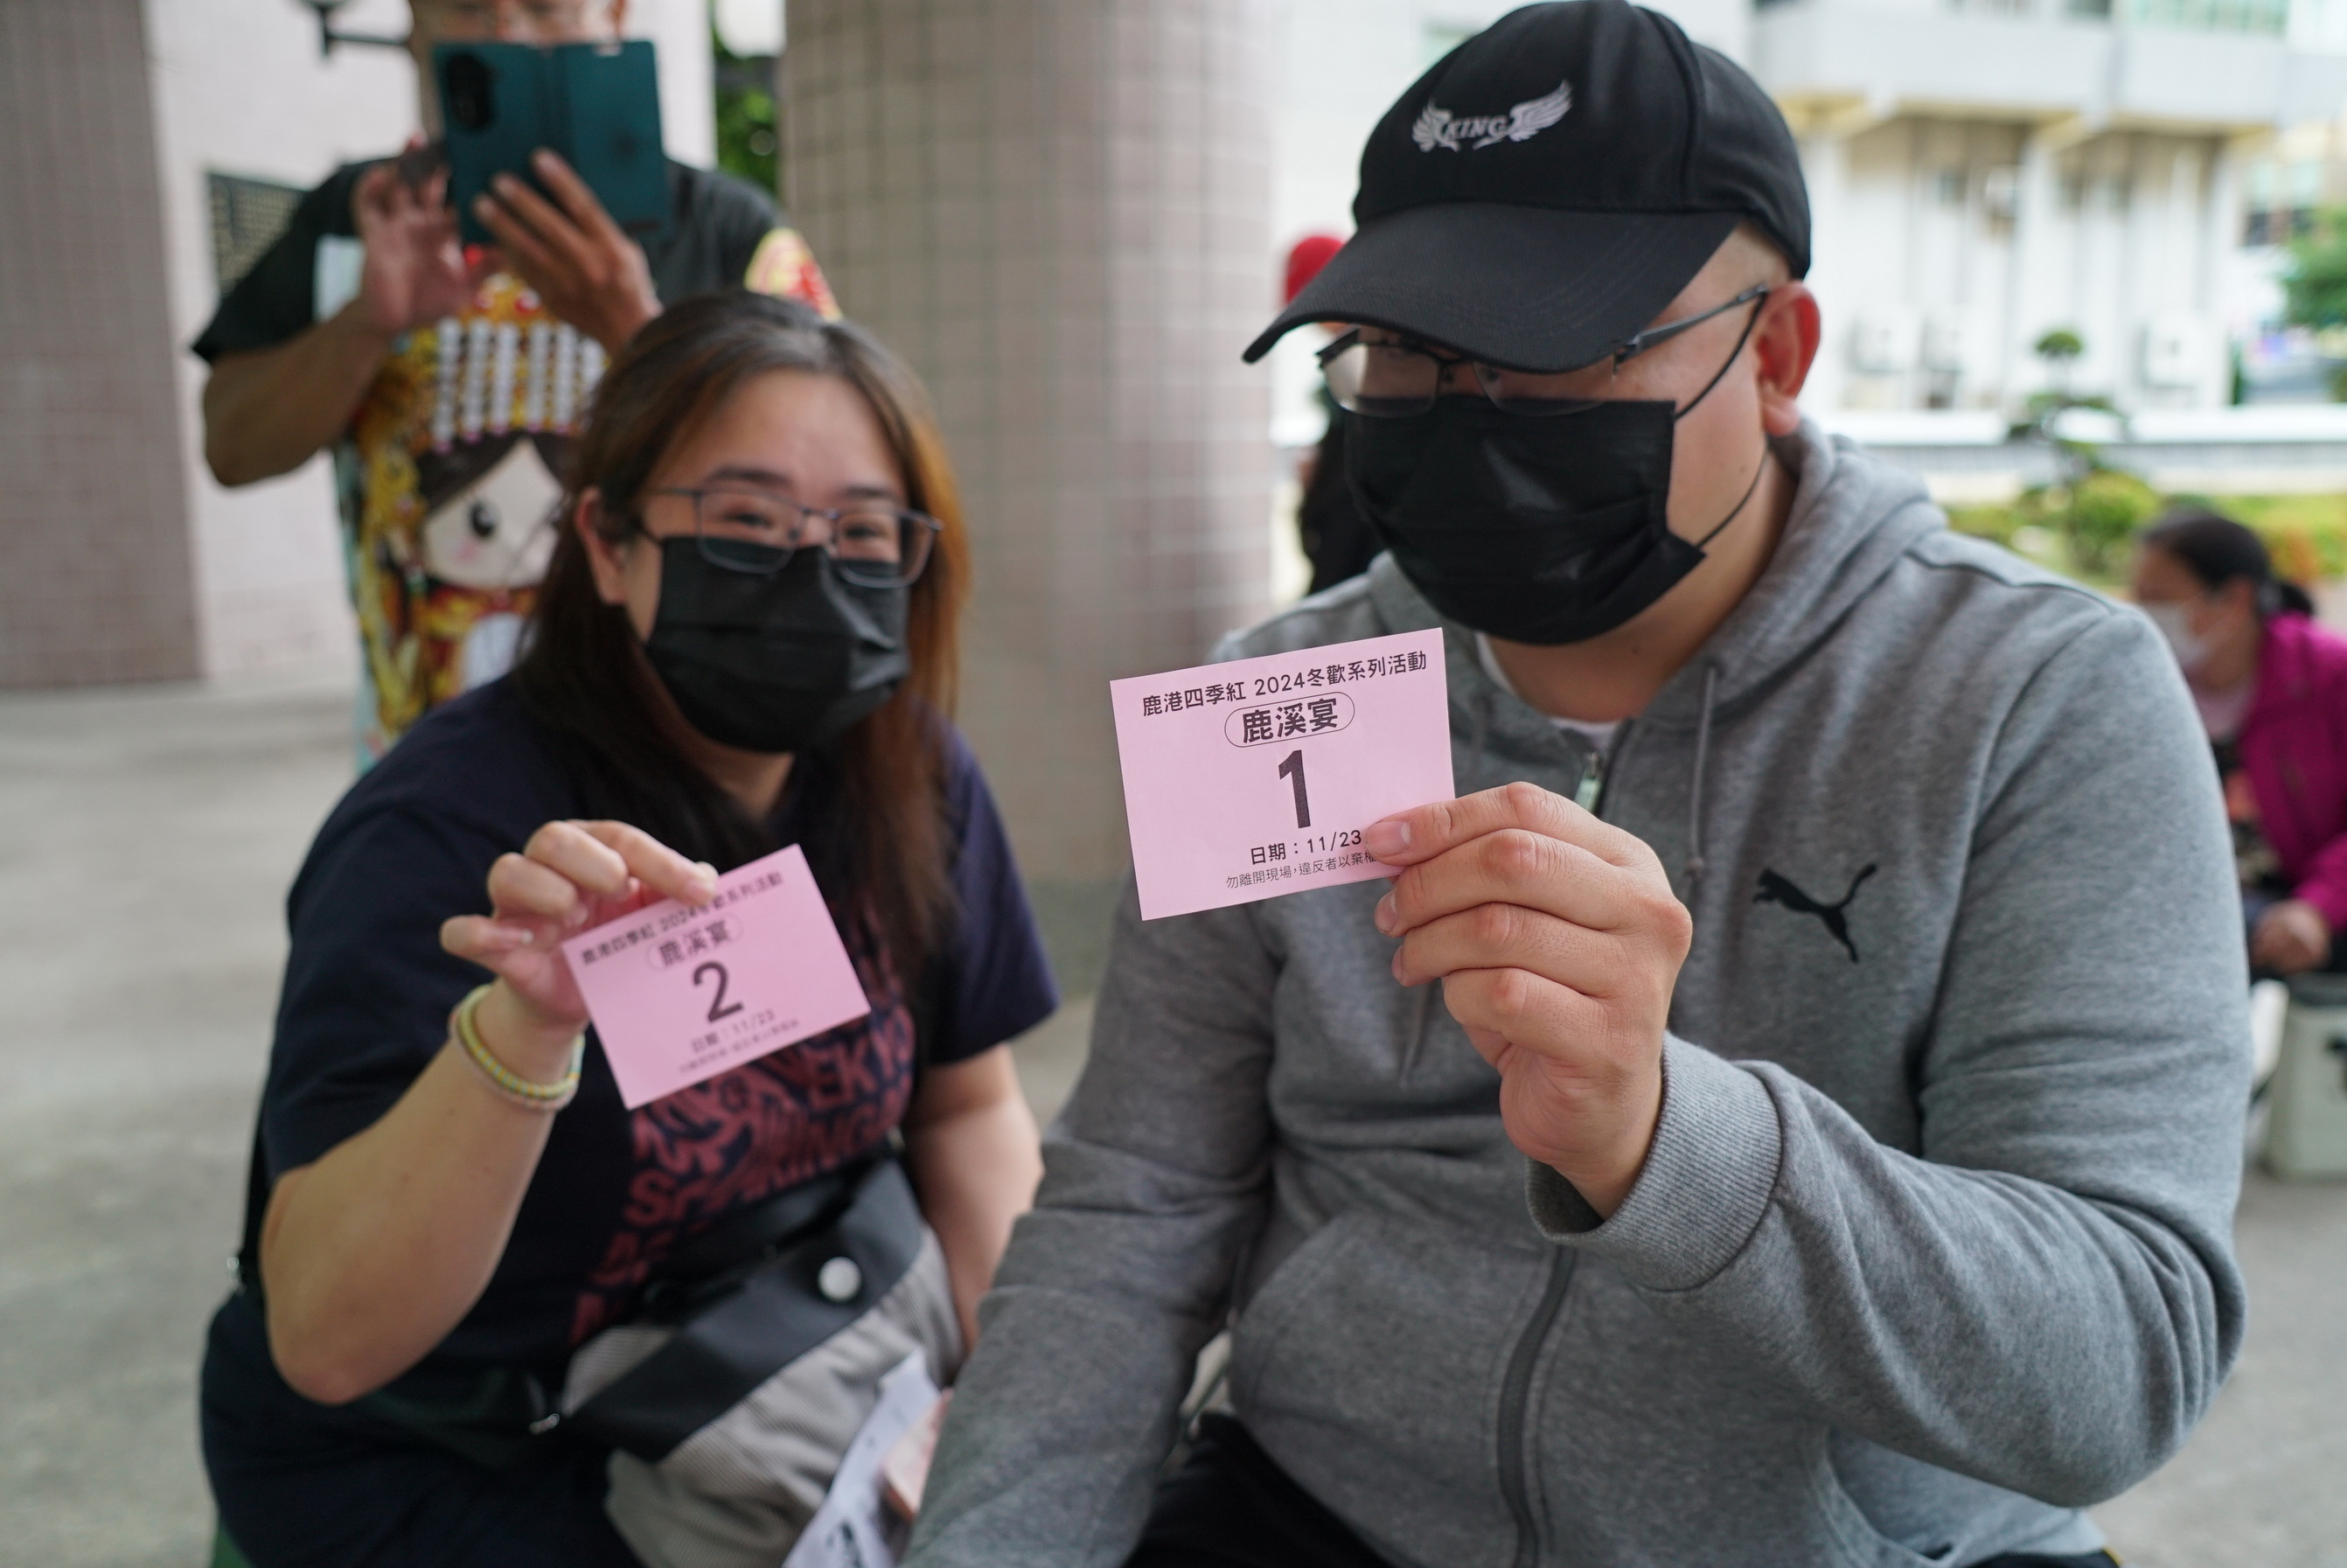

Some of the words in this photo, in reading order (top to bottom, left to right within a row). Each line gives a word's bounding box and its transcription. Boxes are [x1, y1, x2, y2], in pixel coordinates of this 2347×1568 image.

[1142, 681, 1246, 716] 鹿港四季紅
[1254, 651, 1427, 696] 2024冬歡系列活動
[1243, 697, 1339, 743] 鹿溪宴
[1278, 749, 1311, 828] 1
[693, 961, 744, 1024] 2
